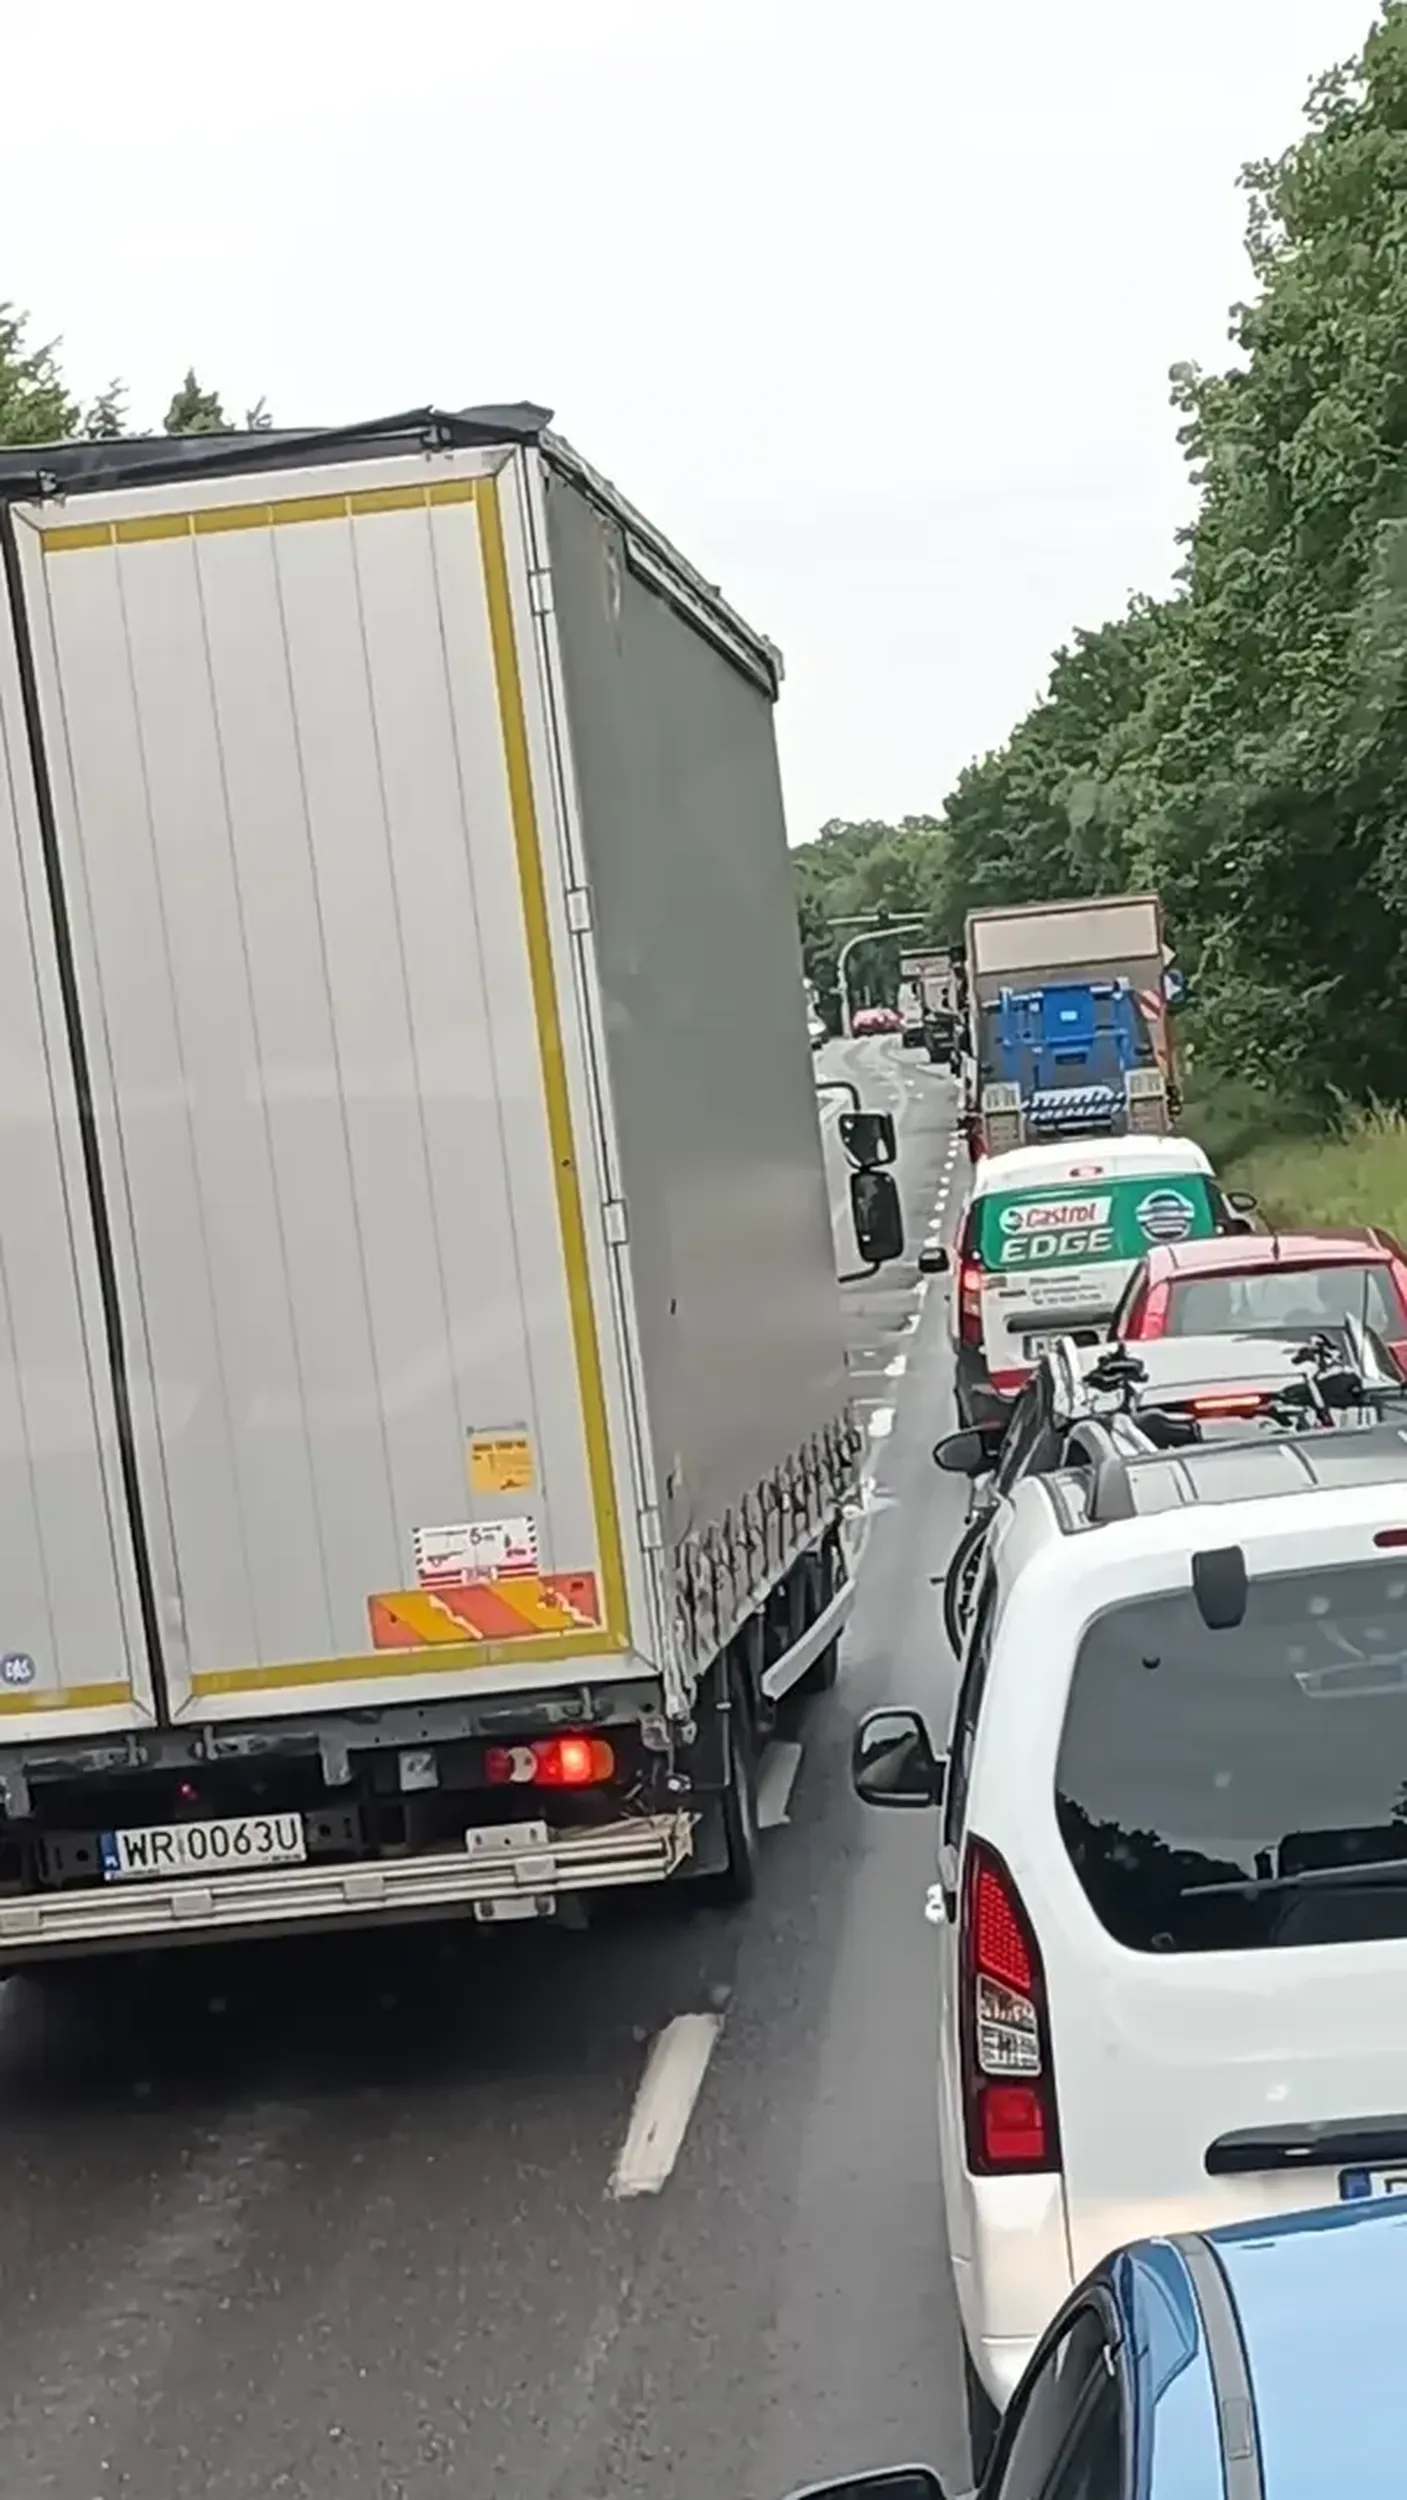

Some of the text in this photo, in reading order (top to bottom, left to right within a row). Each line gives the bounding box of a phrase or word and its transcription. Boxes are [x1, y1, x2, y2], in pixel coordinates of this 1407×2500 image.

[1025, 1202, 1098, 1228] Castrol
[1000, 1227, 1115, 1263] EDGE
[123, 1818, 298, 1867] WR 0063U
